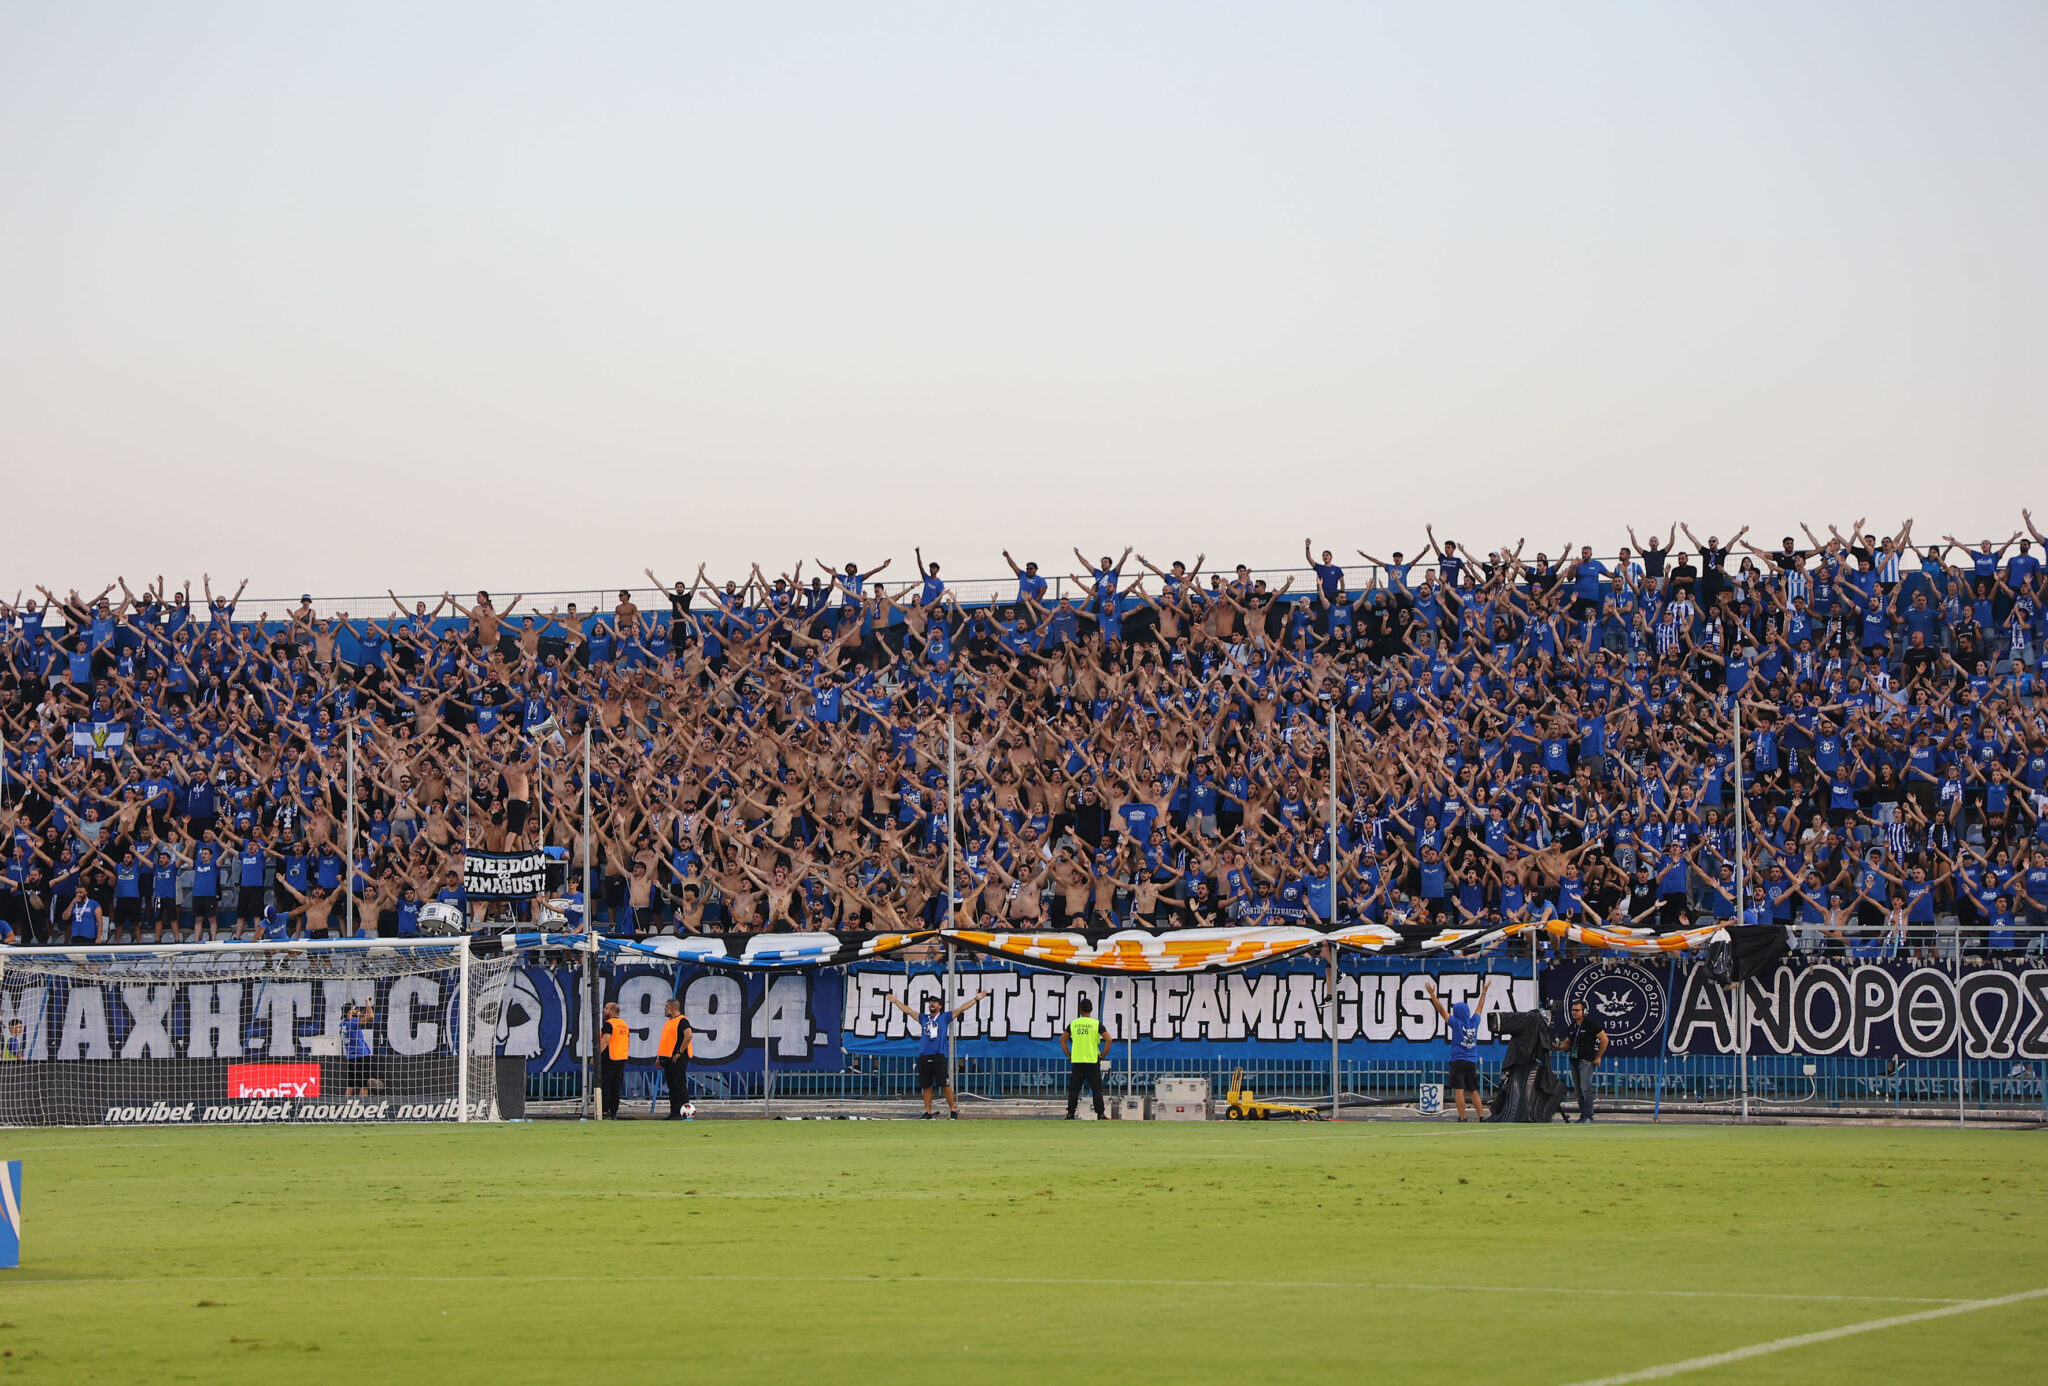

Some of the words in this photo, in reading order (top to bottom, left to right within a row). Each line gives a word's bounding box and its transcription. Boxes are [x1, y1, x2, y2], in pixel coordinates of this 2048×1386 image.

[464, 853, 546, 874] FREEDOM
[498, 872, 511, 880] to
[1151, 971, 1516, 1044] FAMAGUSTA
[1603, 1020, 1630, 1029] 1911
[1420, 1085, 1438, 1099] PC
[105, 1101, 195, 1121] novibet
[202, 1100, 293, 1120] novibet
[298, 1099, 389, 1119] novibet
[396, 1098, 489, 1119] novibet
[1421, 1096, 1440, 1112] 94
